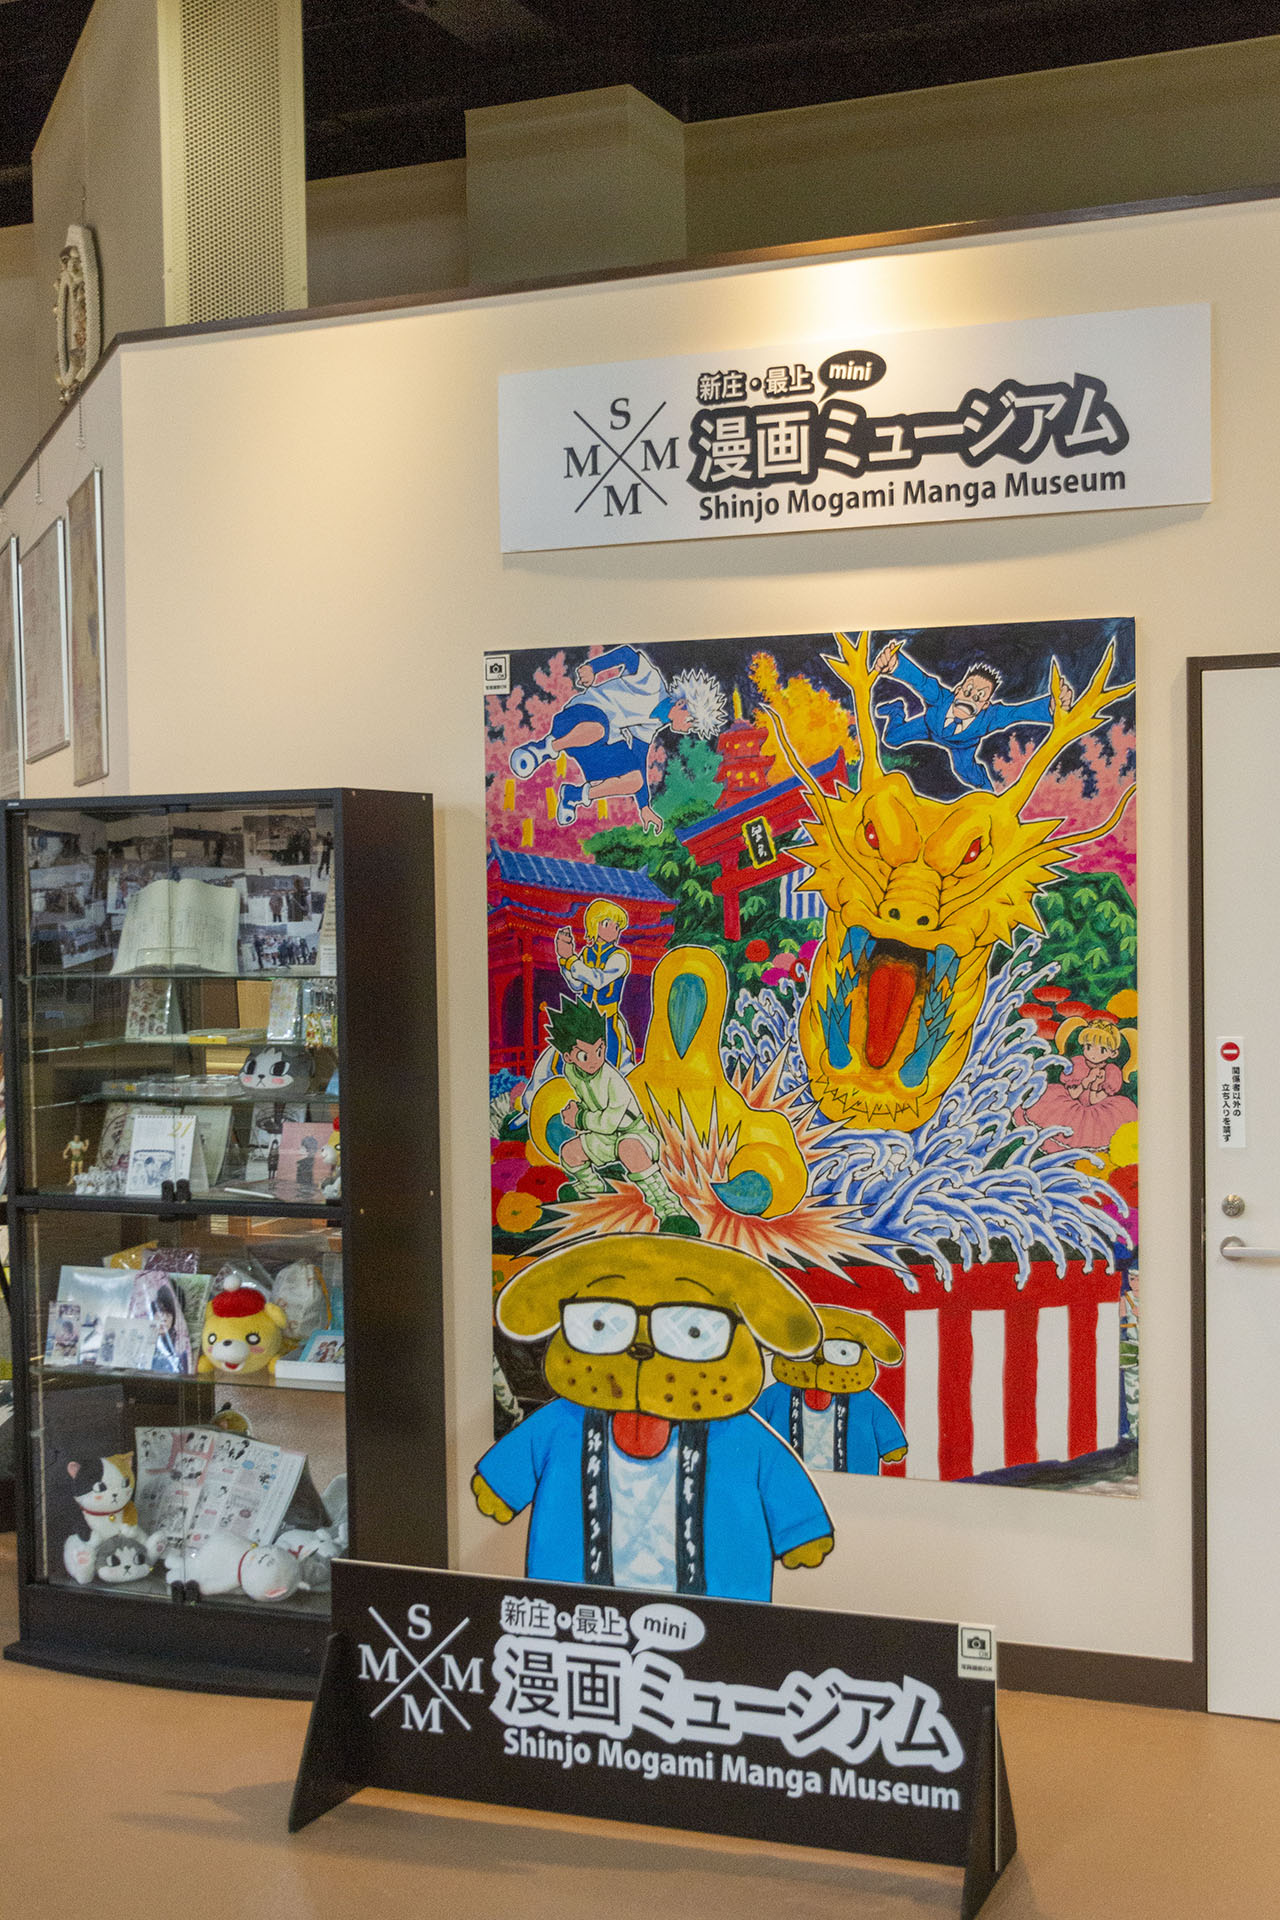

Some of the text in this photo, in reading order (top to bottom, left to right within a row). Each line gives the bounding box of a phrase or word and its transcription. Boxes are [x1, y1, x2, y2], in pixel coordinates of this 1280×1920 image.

[698, 364, 813, 401] 新庄・最上
[827, 360, 873, 382] mini
[610, 398, 631, 430] S
[695, 383, 1121, 485] 漫画ミュージアム
[563, 437, 680, 478] M M
[603, 483, 642, 517] M
[700, 470, 1126, 523] Shinjo Mogami Manga Museum
[1232, 1066, 1241, 1117] 関係者以外の
[407, 1603, 432, 1640] S
[503, 1598, 624, 1639] 新庄・最上
[643, 1615, 687, 1640] mini
[357, 1643, 484, 1694] M M
[401, 1693, 444, 1734] M
[500, 1643, 954, 1762] 漫画ミュージアム
[503, 1727, 961, 1811] Shinjo Mogami Manga Museum
